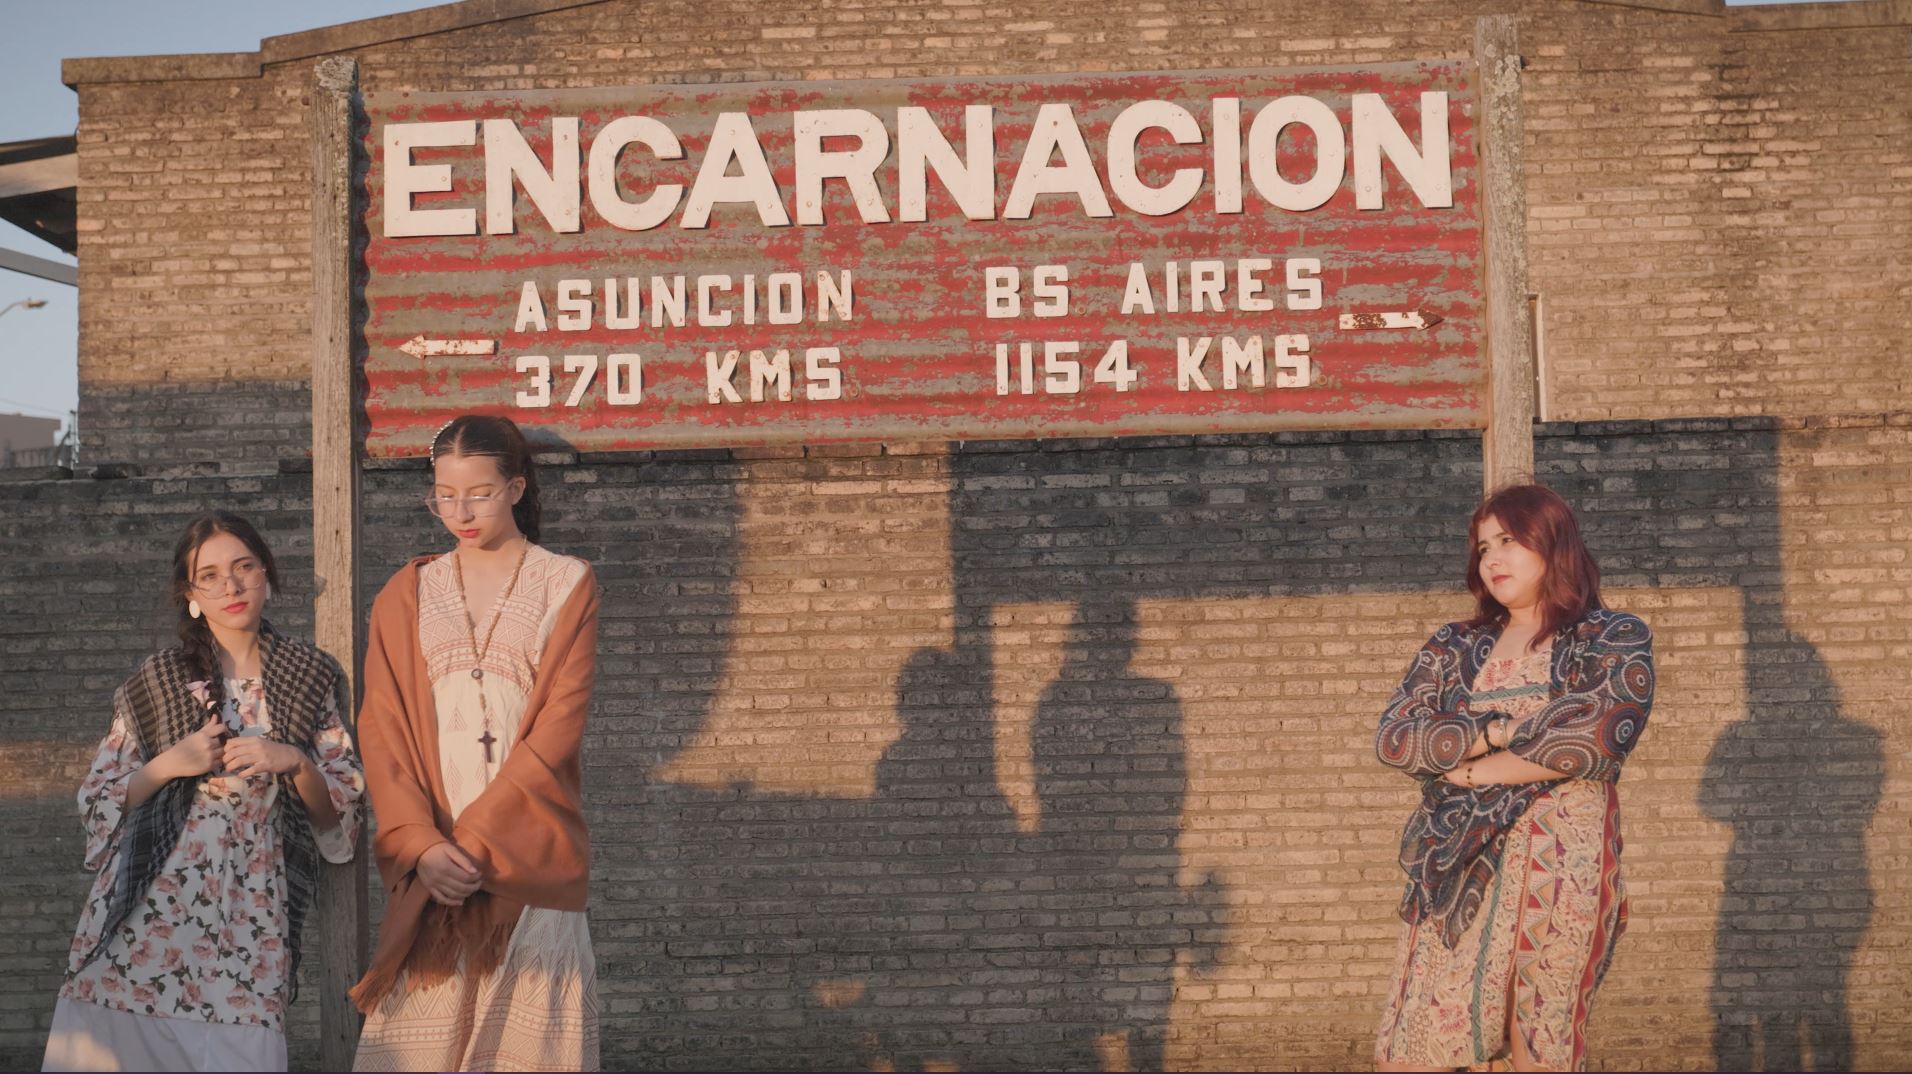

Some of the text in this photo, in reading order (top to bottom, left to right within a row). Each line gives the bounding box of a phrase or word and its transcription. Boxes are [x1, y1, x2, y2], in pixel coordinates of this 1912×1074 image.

[383, 90, 1454, 239] ENCARNACION
[514, 269, 853, 333] ASUNCION
[985, 256, 1323, 319] BS AIRES
[515, 346, 842, 408] 370 KMS
[995, 333, 1312, 396] 1154 KMS
